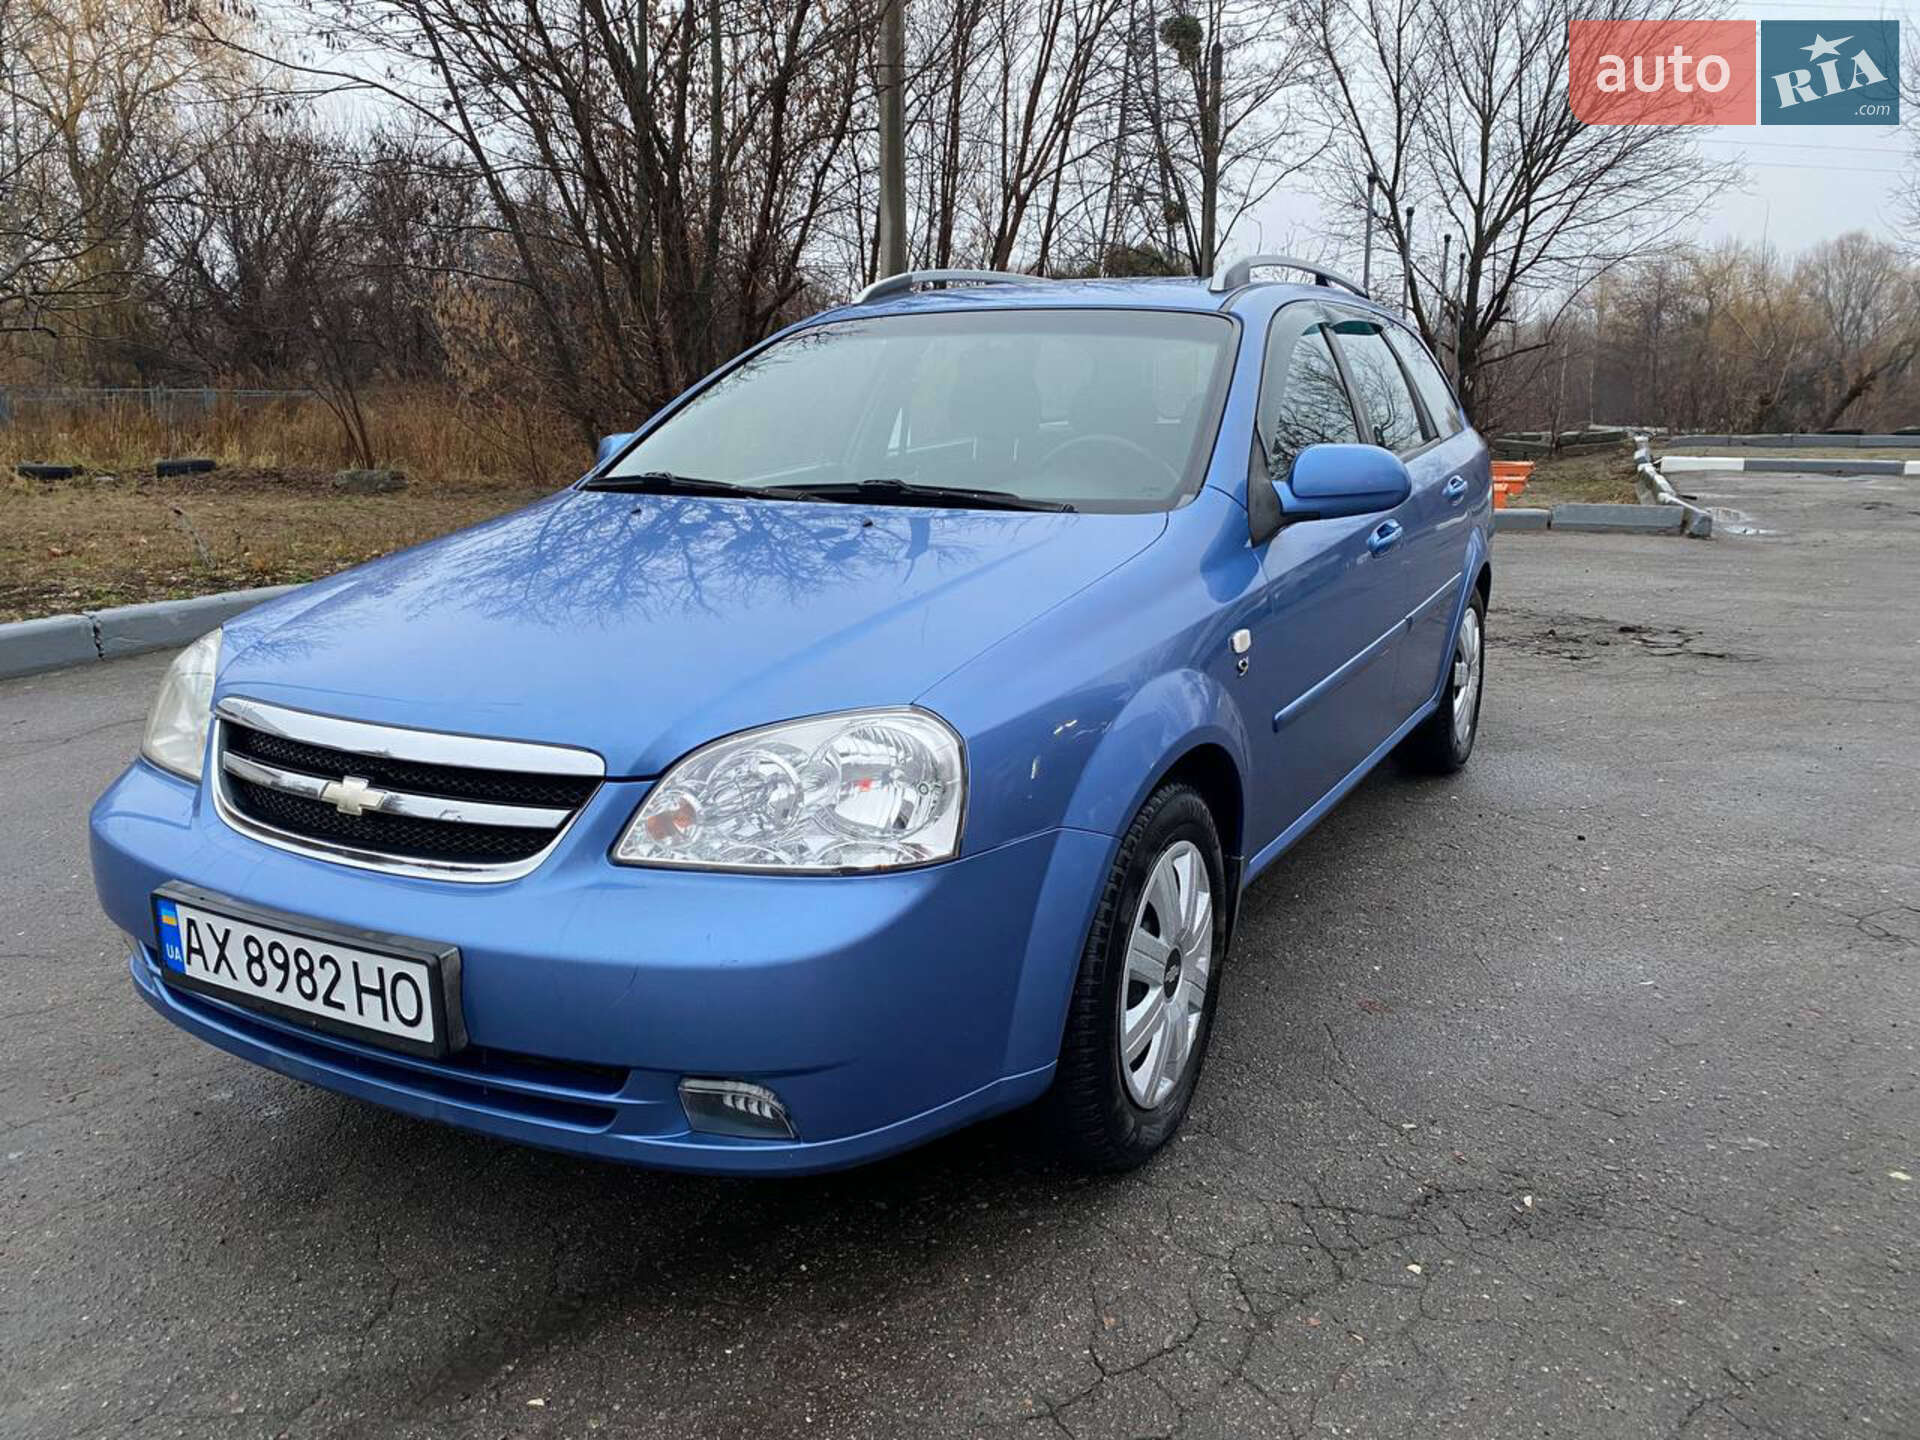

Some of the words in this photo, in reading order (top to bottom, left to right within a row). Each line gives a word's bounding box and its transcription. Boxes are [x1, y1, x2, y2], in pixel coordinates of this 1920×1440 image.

[165, 943, 184, 962] UA
[185, 918, 238, 980] AX
[243, 935, 346, 1011] 8982
[352, 961, 423, 1028] HO
